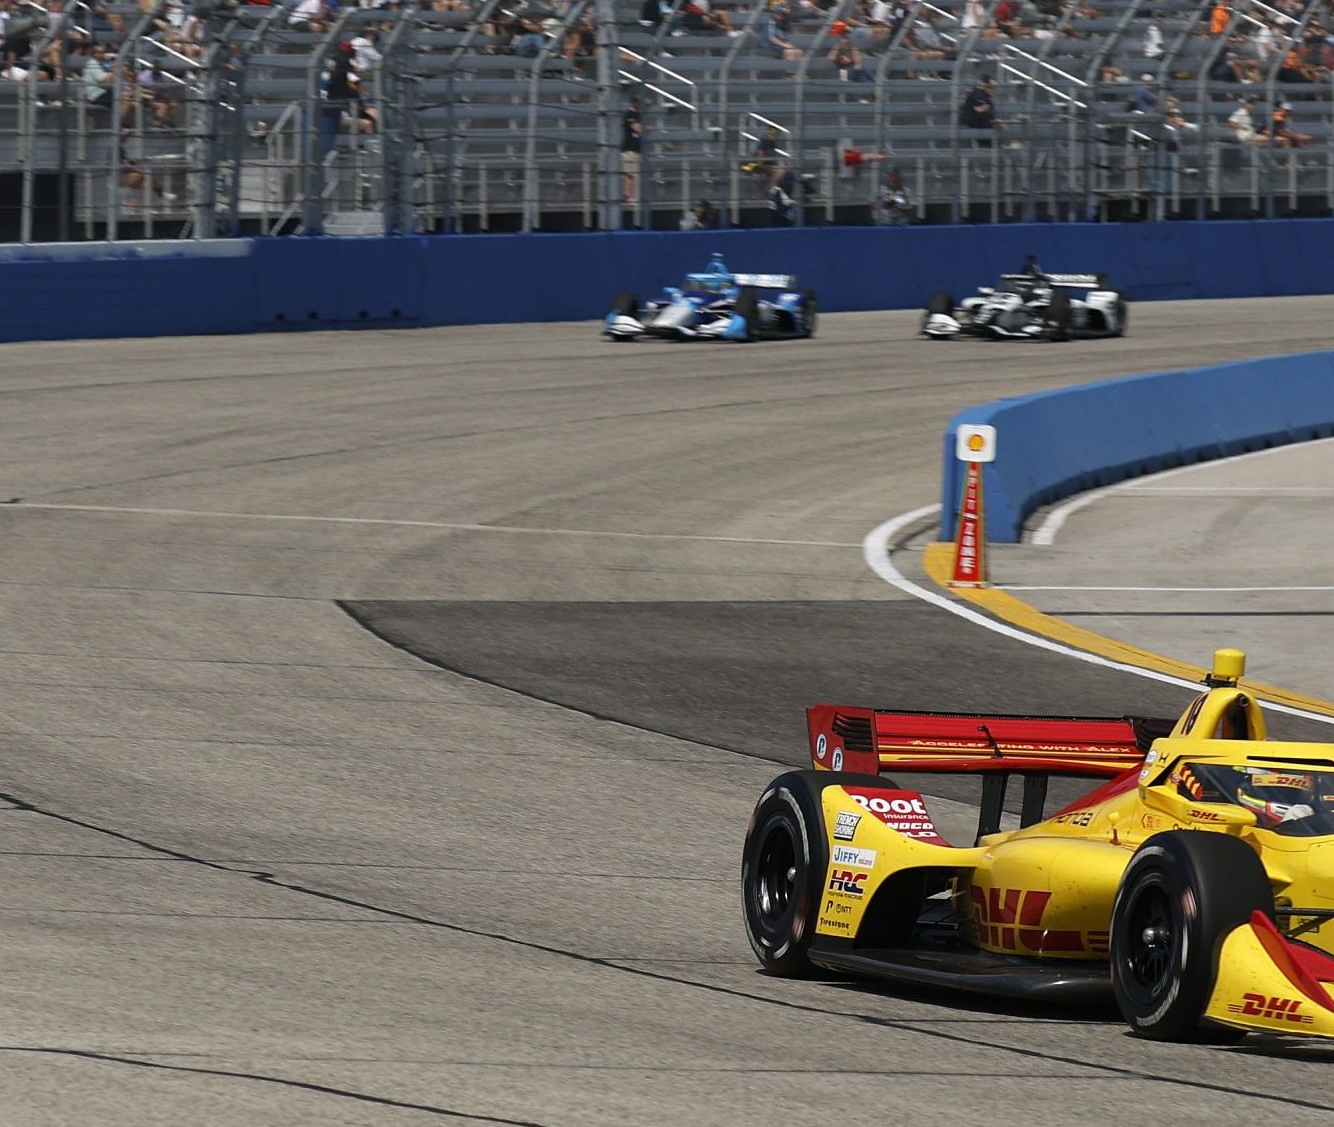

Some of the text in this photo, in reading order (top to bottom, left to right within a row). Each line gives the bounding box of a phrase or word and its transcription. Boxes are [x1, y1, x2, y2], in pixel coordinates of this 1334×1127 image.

[1039, 744, 1080, 752] WITH
[1085, 745, 1131, 753] ALEX
[1190, 809, 1220, 821] DHL
[820, 917, 850, 929] Firestone
[971, 885, 1085, 952] DHL
[1242, 992, 1304, 1023] DHL
